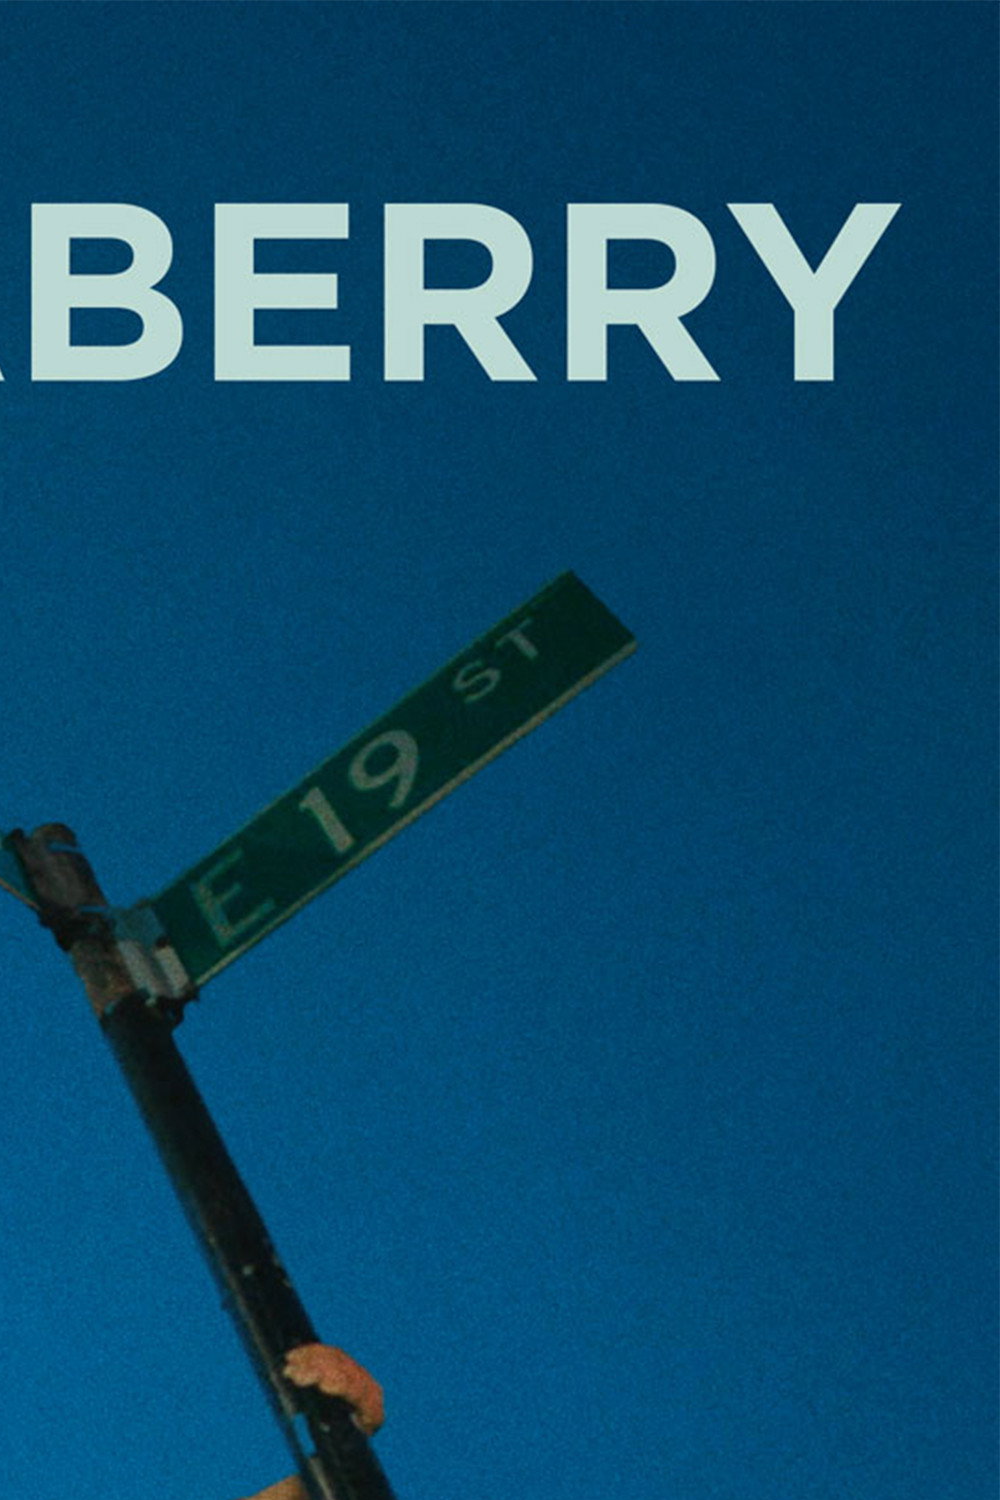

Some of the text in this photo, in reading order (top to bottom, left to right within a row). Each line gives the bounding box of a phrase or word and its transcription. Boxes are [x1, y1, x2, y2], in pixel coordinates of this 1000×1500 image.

[189, 617, 540, 947] E 19 ST
